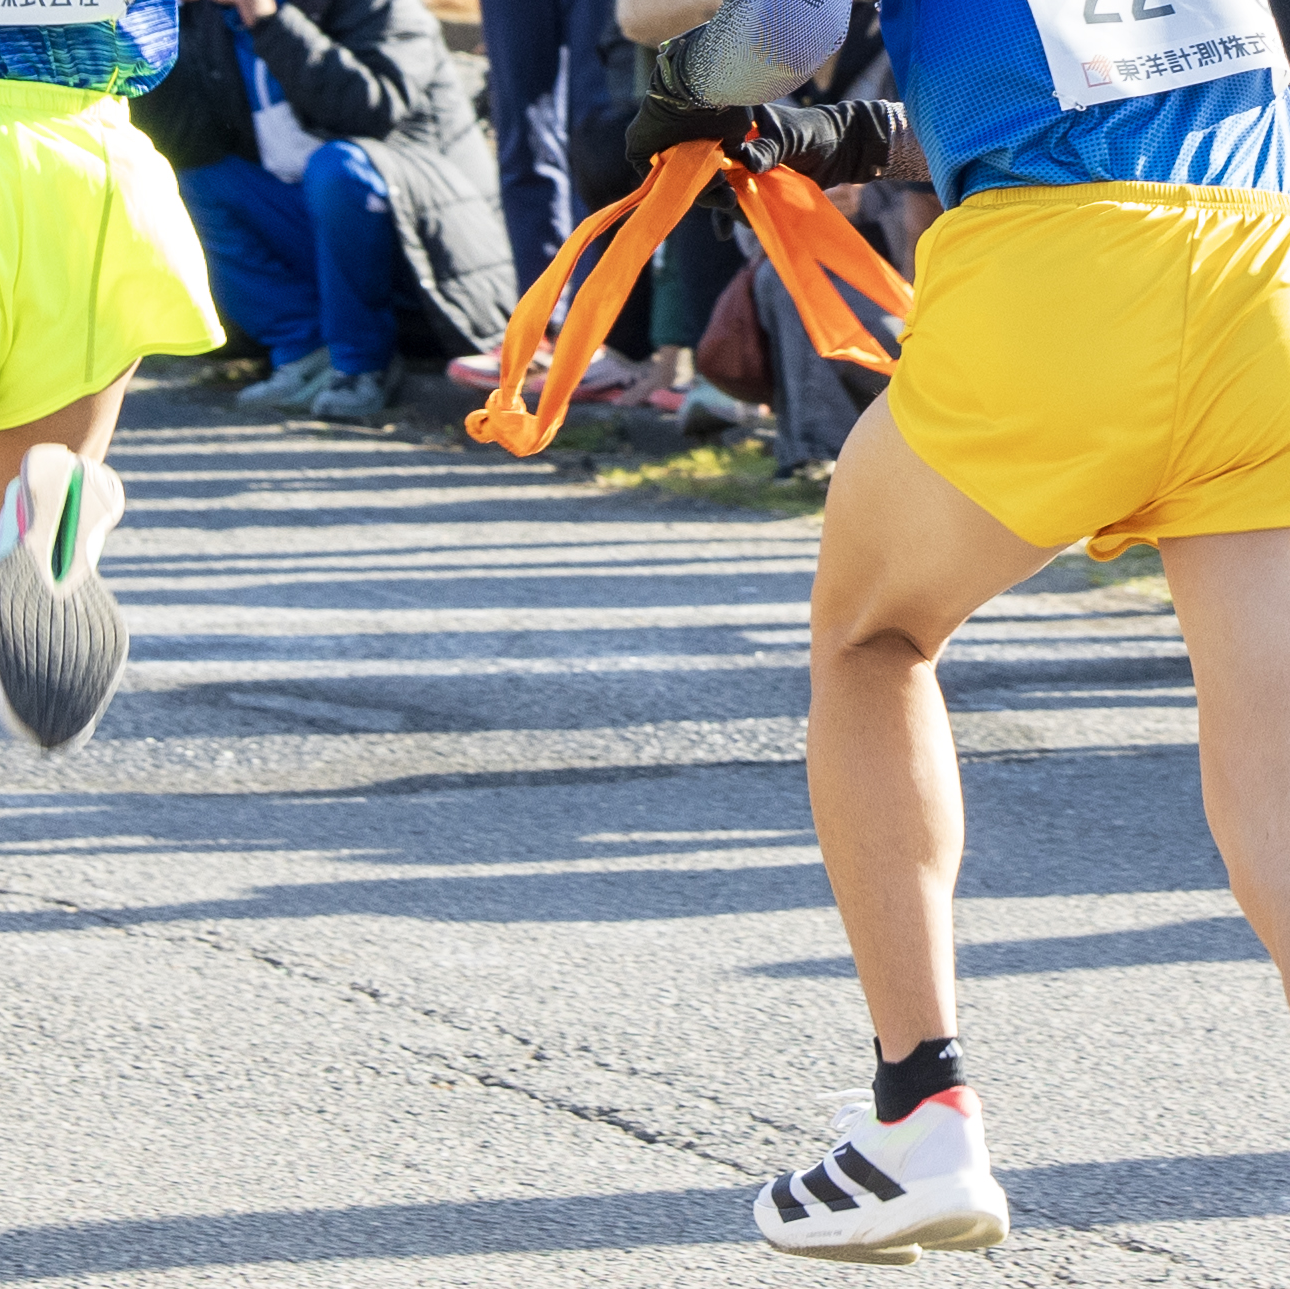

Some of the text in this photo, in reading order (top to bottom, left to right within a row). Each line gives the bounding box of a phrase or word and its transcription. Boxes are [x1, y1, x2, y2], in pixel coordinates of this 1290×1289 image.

[1113, 32, 1281, 83] 東洋計測株式
